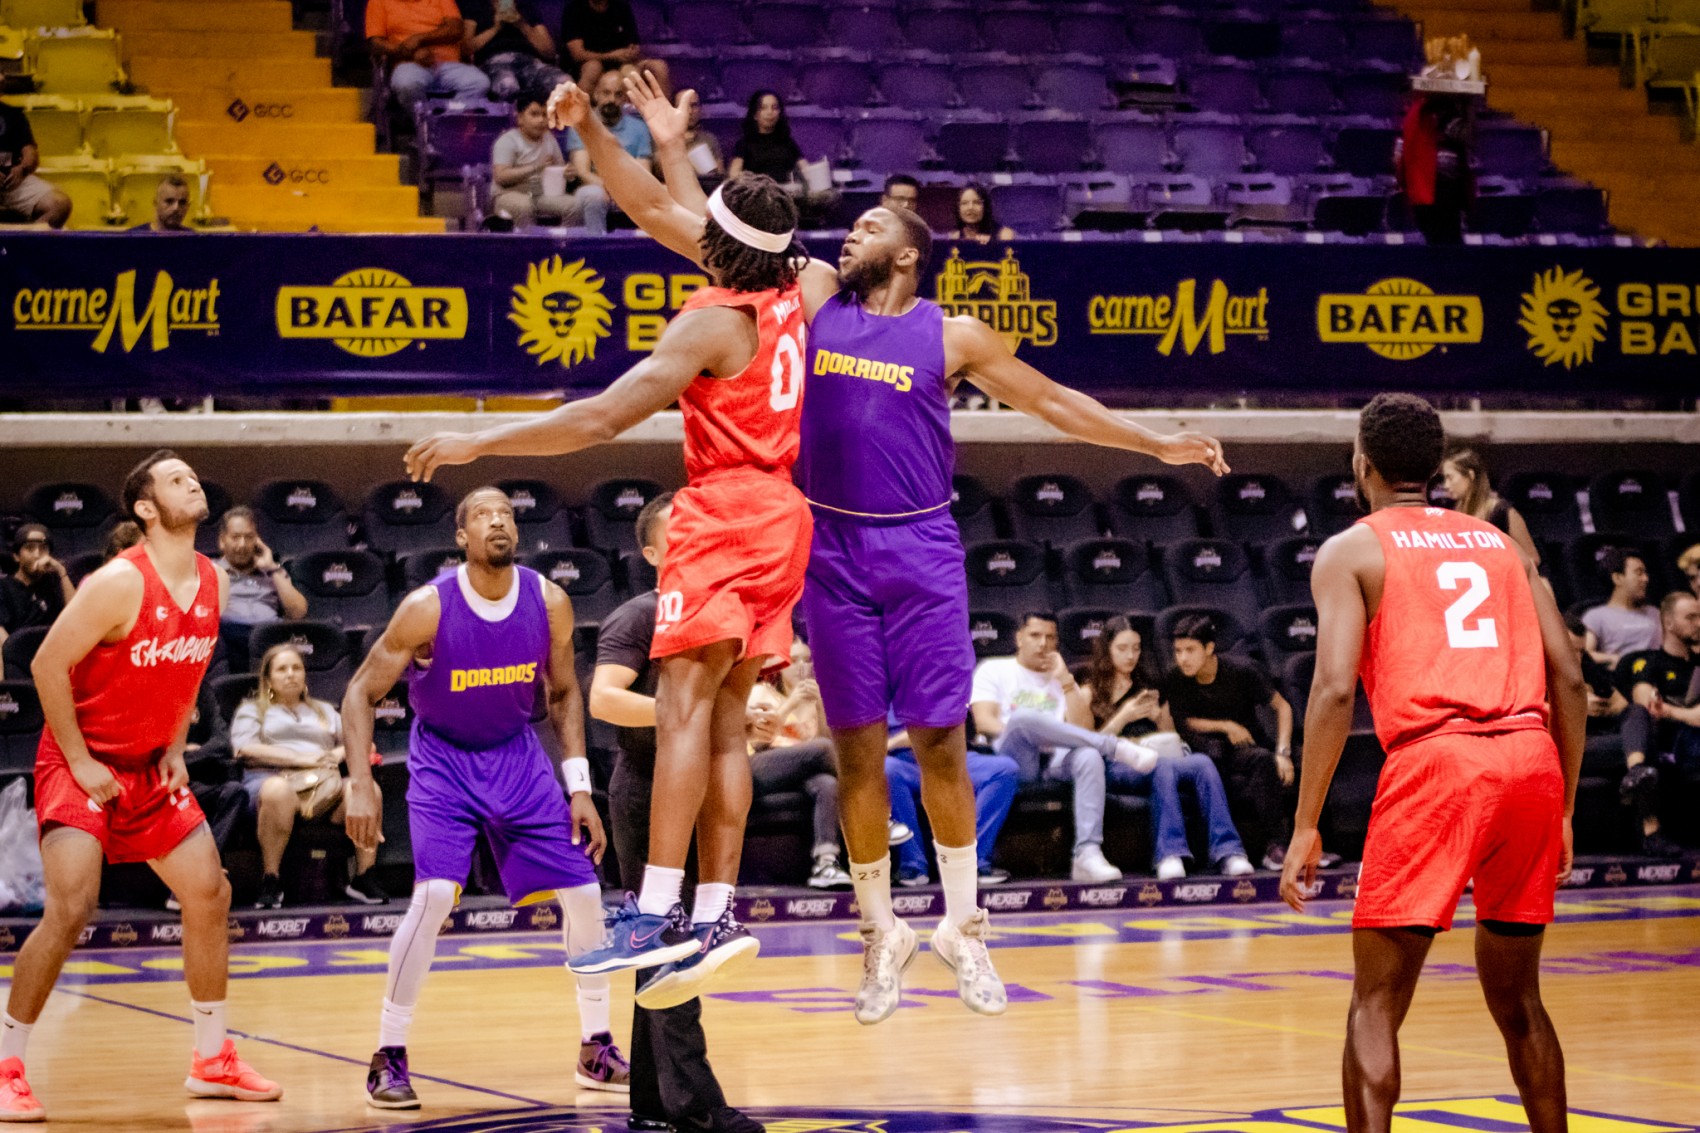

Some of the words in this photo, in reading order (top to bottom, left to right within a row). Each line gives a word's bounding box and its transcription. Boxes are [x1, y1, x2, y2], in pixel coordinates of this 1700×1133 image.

[254, 104, 294, 118] GCC
[290, 169, 329, 184] GCC
[1618, 283, 1700, 317] GR
[291, 296, 451, 328] BAFAR
[1330, 303, 1469, 334] BAFAR
[938, 301, 1057, 344] ADOS
[813, 348, 915, 392] DORADOS
[1391, 529, 1506, 549] HAMILTON
[1436, 561, 1499, 648] 2
[450, 662, 538, 692] DORADOS
[858, 869, 880, 880] 23
[983, 891, 1032, 907] MEXBET
[1080, 887, 1128, 903] MEXBET
[1174, 883, 1222, 899] MEXBET
[787, 899, 837, 915] MEXBET
[362, 915, 404, 931] MEXB
[467, 909, 518, 926] MEXBET
[152, 924, 182, 939] MEX
[258, 918, 310, 936] MEXBET
